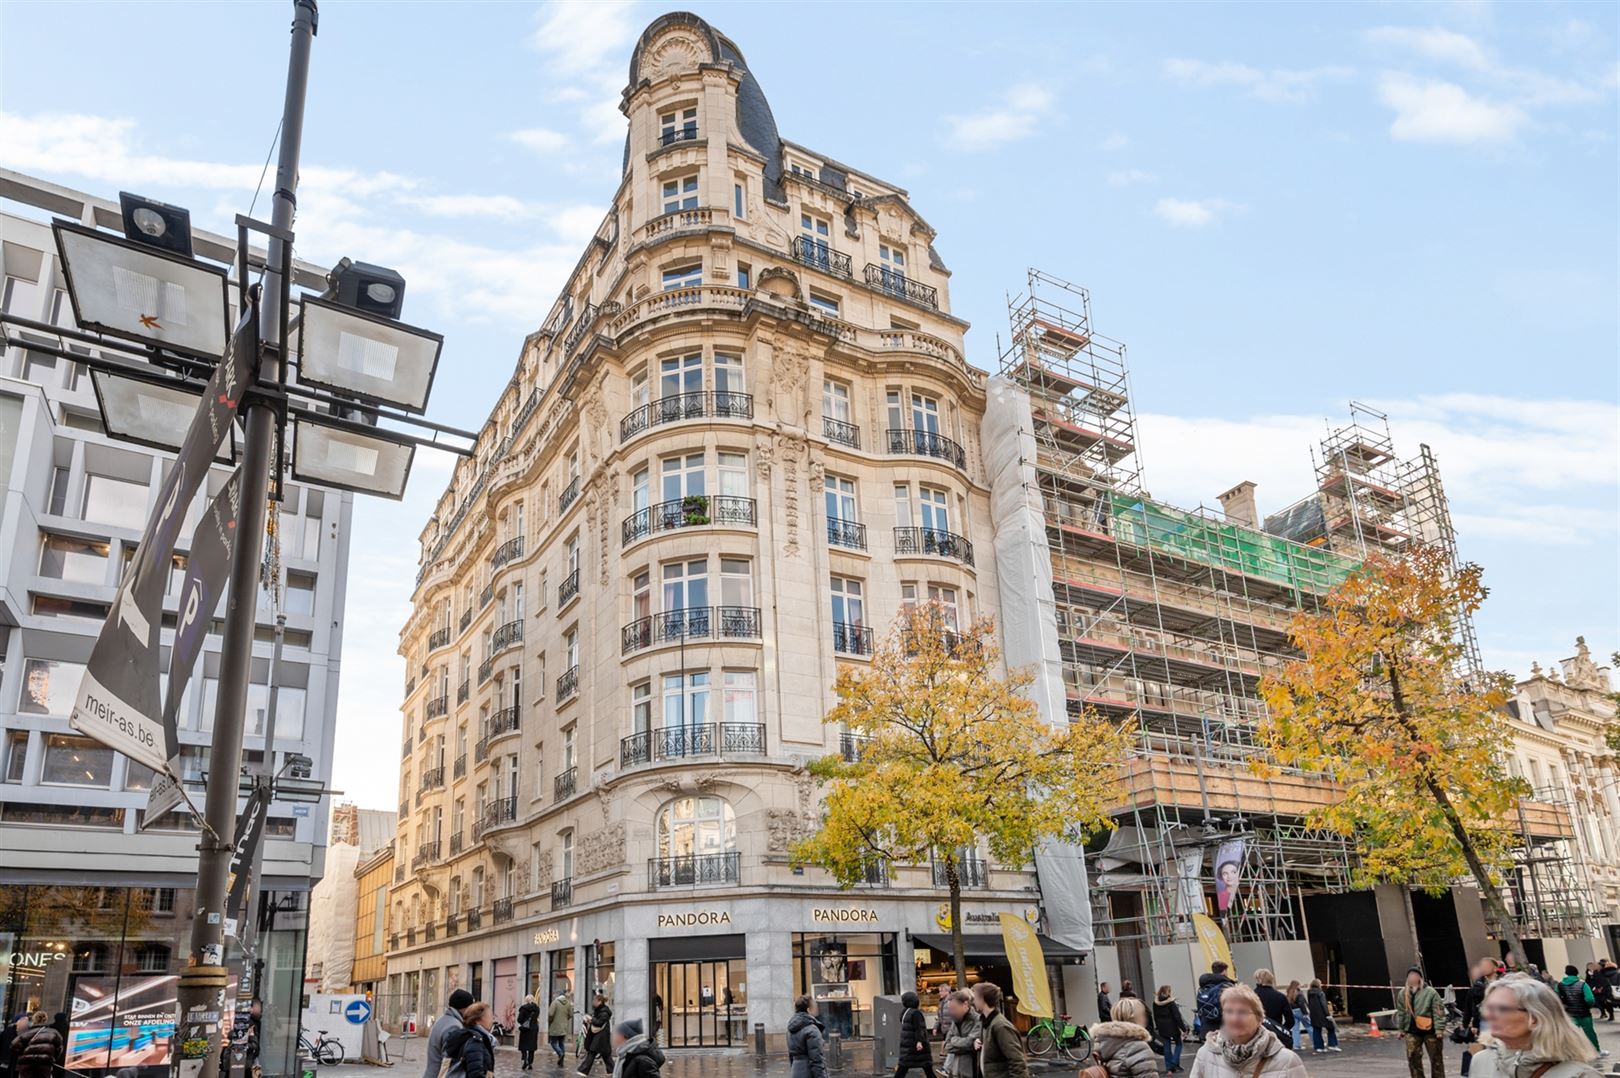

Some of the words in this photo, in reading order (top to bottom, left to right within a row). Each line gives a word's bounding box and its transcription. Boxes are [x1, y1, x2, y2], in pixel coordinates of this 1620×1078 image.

[85, 693, 154, 747] meir-as.be
[657, 911, 731, 927] PANDORA
[813, 909, 879, 921] PANDORA
